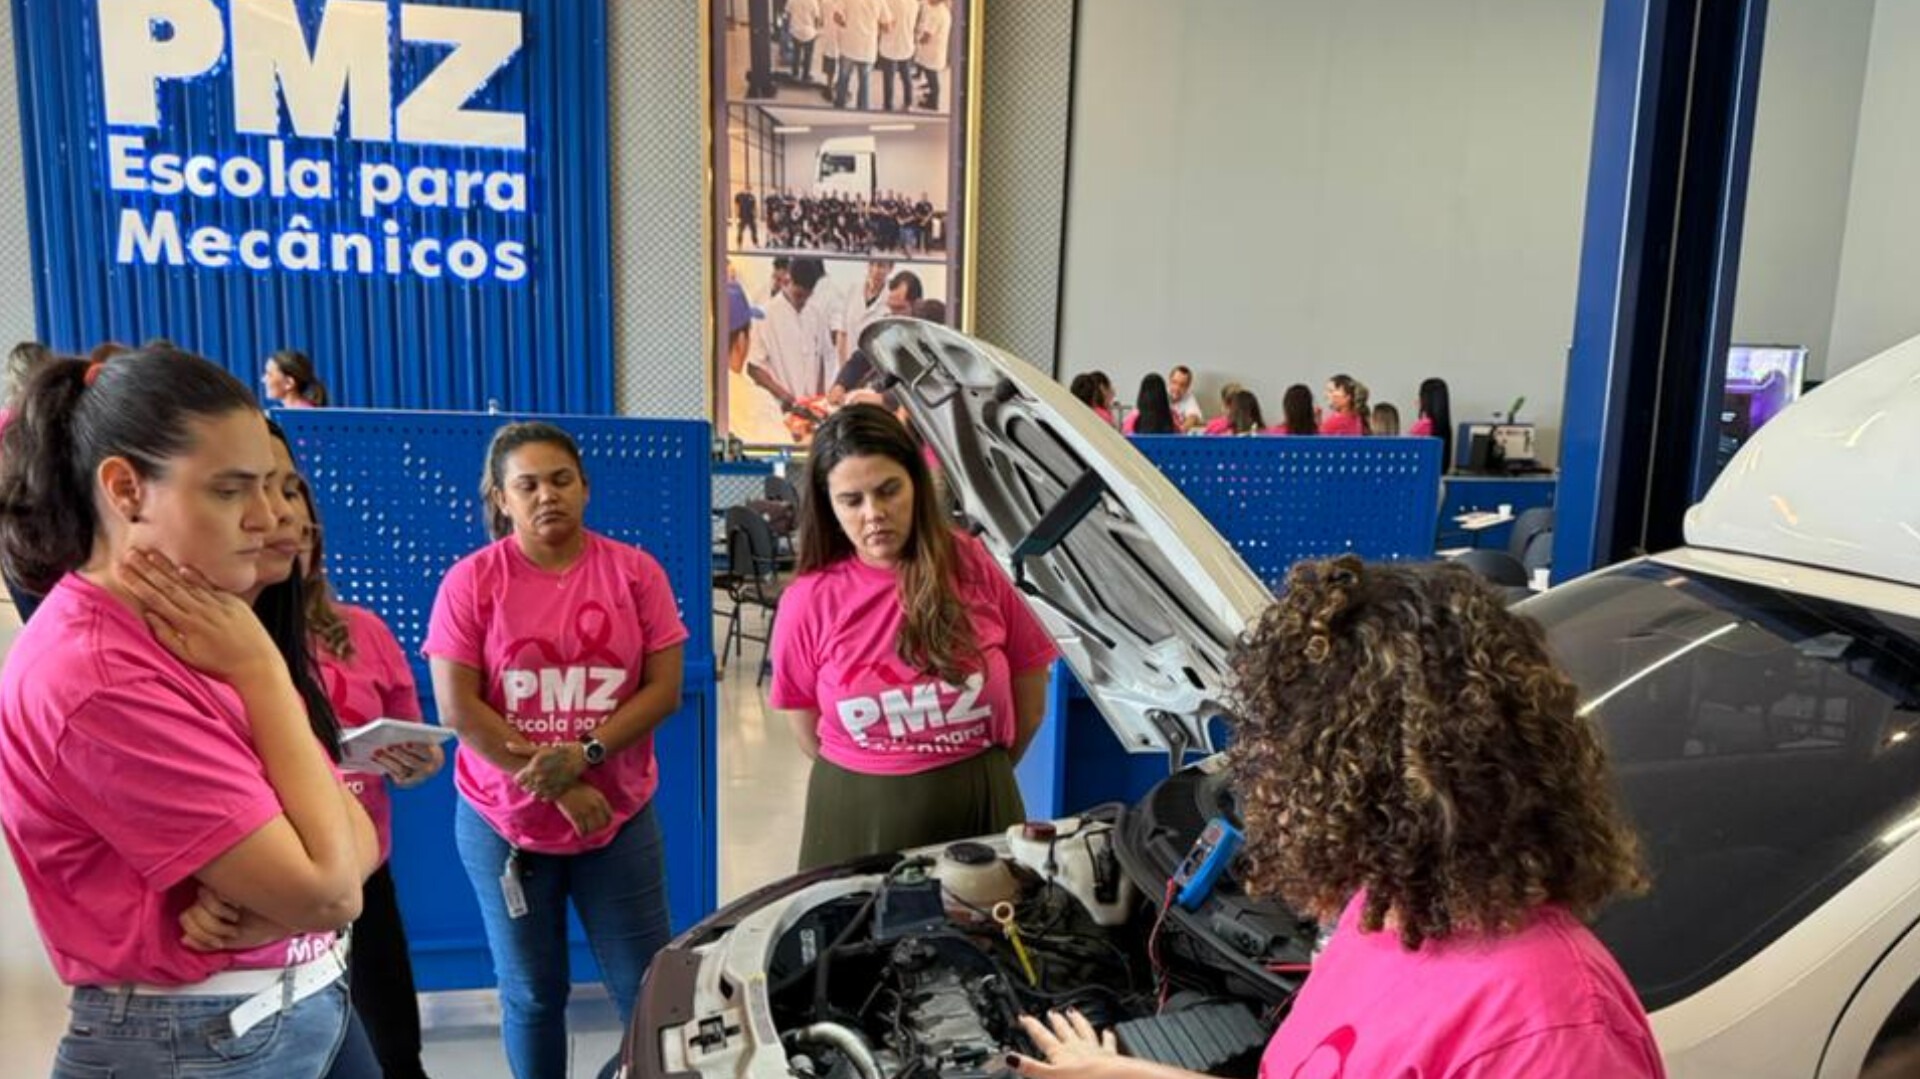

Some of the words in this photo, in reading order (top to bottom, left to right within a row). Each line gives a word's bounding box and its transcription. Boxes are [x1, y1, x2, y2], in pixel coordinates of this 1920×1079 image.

[98, 0, 525, 149] PMZ
[108, 134, 331, 199] Escola
[360, 161, 526, 217] para
[117, 208, 527, 280] Mecânicos
[503, 666, 627, 712] PMZ
[836, 672, 992, 741] PMZ
